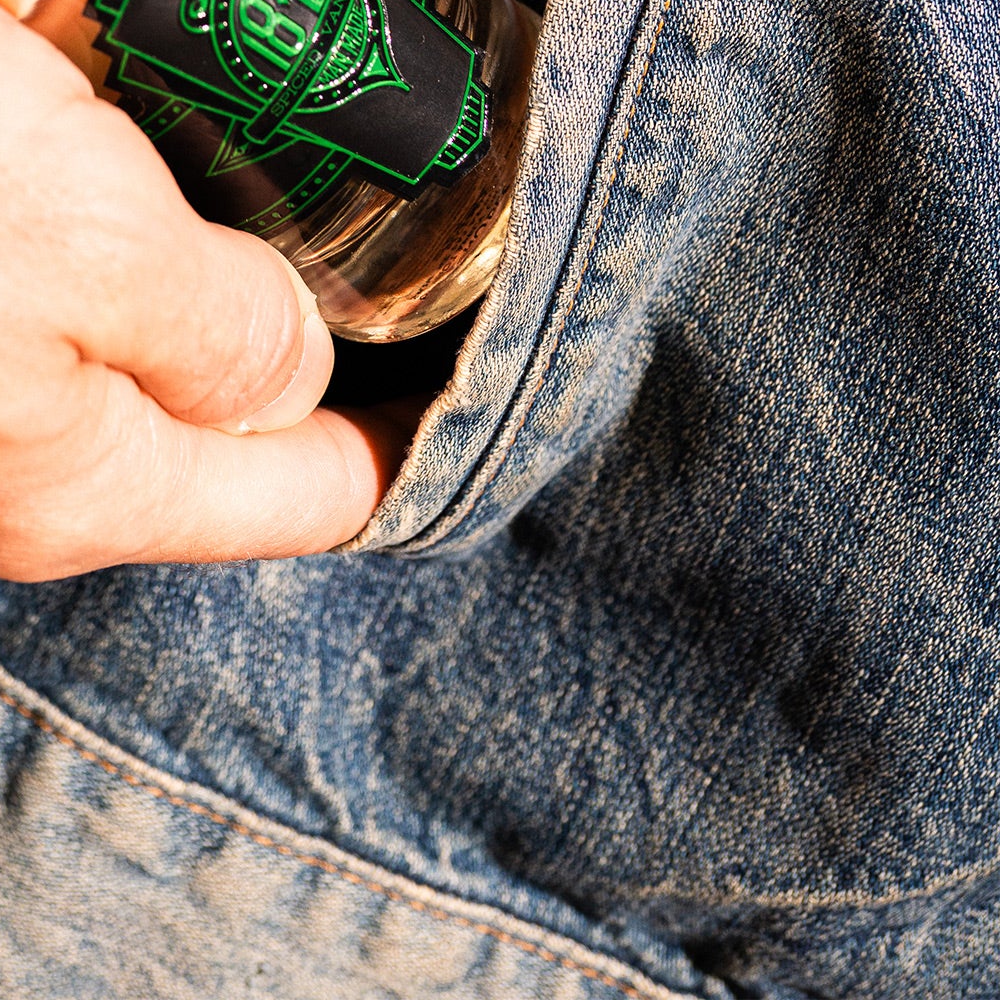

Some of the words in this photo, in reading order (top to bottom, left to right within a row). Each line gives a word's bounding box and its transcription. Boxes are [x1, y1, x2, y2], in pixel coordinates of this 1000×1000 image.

[318, 50, 354, 84] MAN
[340, 4, 364, 57] MADE
[270, 49, 324, 117] SPICED
